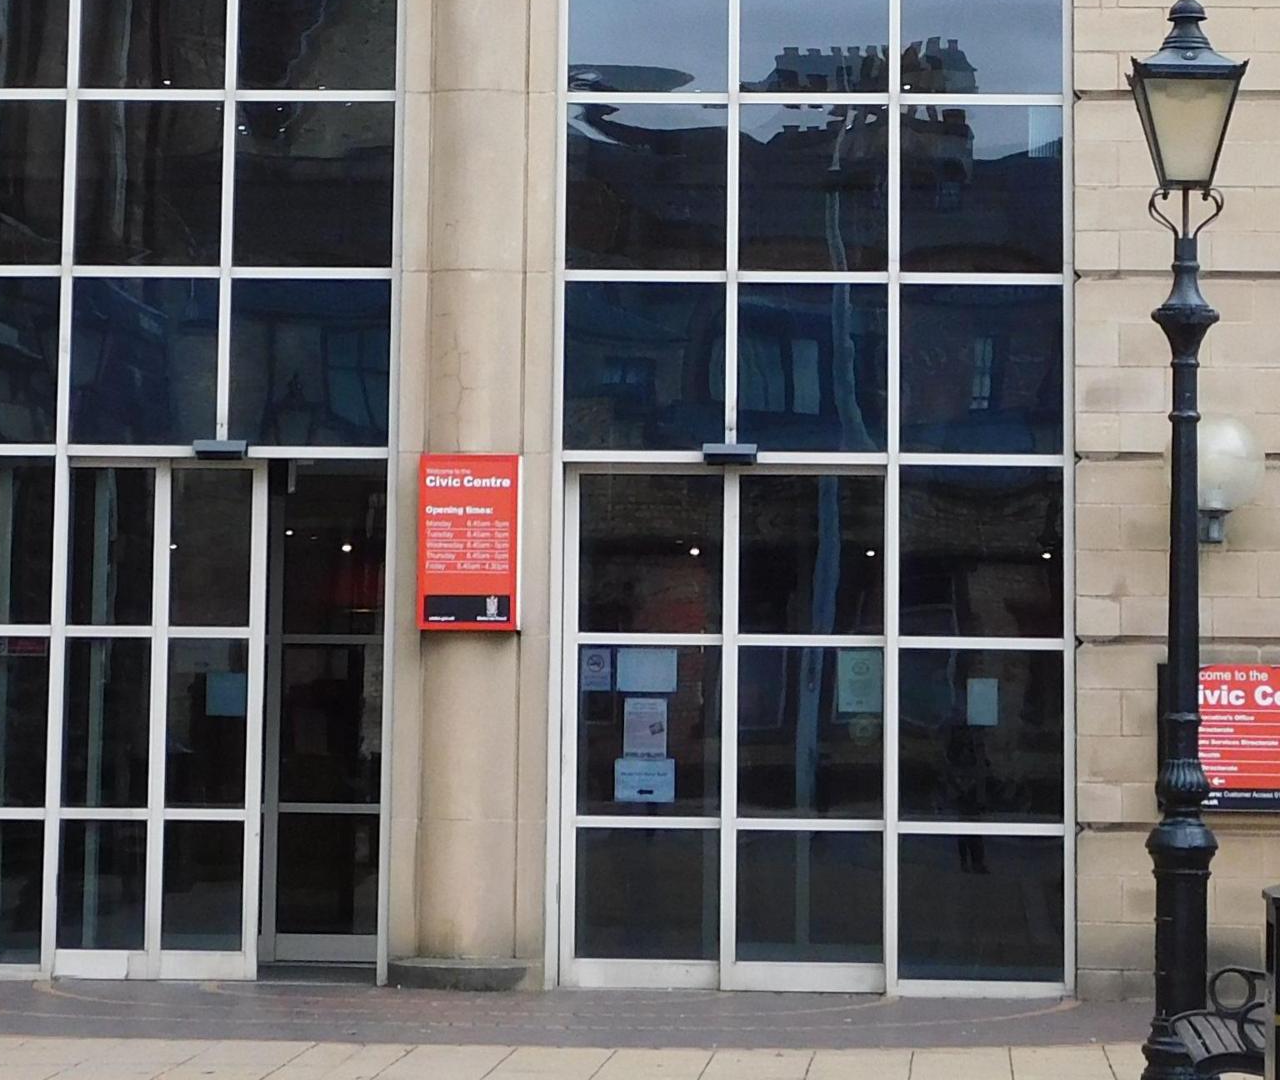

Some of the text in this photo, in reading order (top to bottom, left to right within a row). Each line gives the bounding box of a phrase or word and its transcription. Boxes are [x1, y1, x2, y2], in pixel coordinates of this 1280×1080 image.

[425, 475, 511, 488] Civic Centre
[425, 505, 464, 516] Opening
[1199, 670, 1269, 681] come to the
[1198, 684, 1246, 706] ivic
